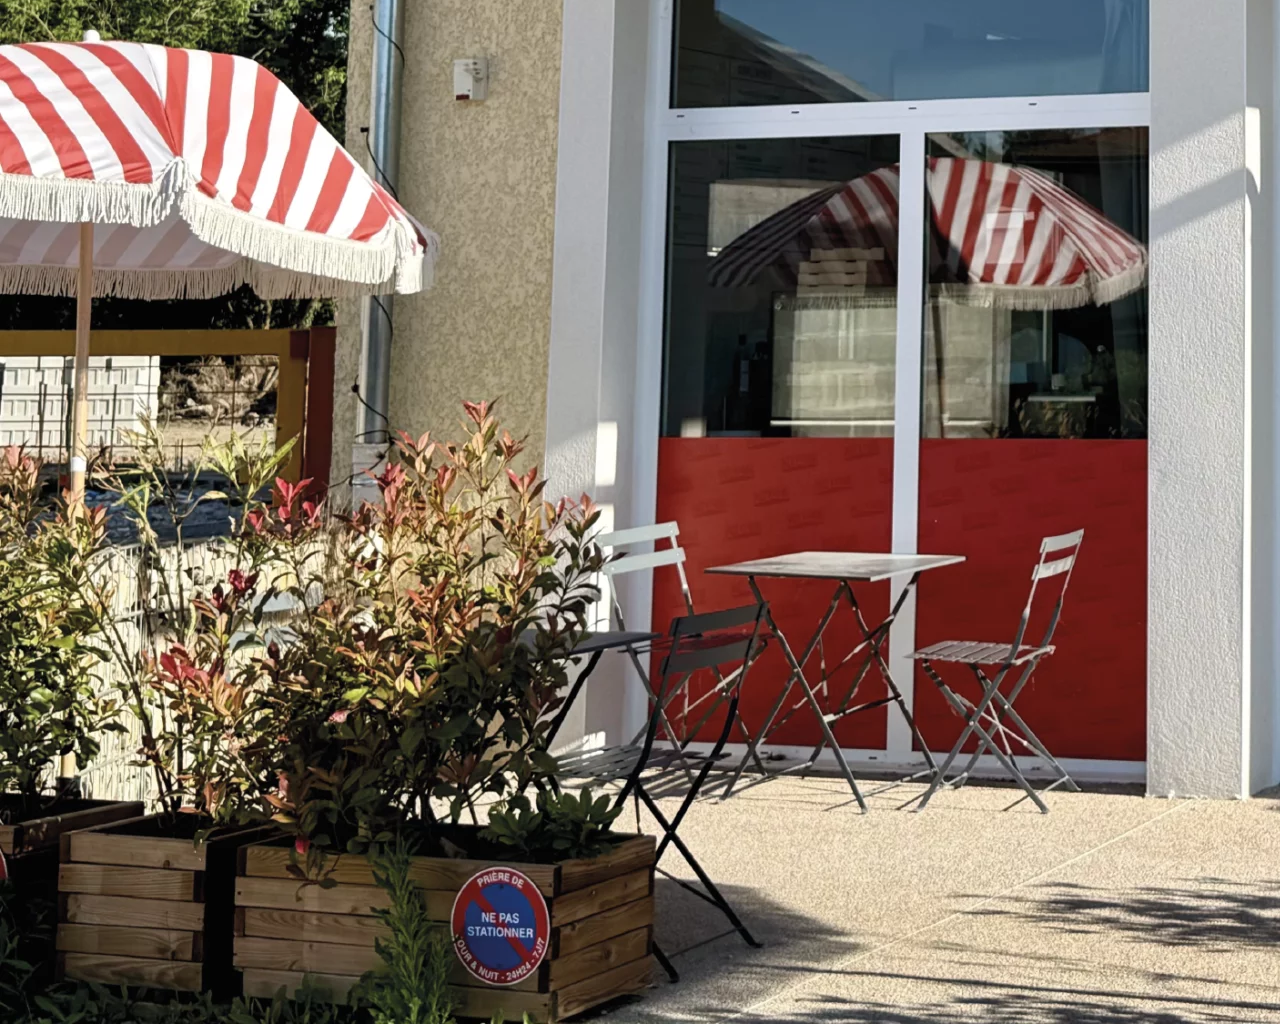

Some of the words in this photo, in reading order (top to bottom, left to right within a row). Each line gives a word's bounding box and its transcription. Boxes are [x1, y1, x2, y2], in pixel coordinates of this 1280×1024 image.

[476, 871, 510, 888] PRIÈRE
[511, 875, 525, 889] DE
[481, 912, 497, 924] NE
[499, 912, 520, 924] PAS
[467, 926, 534, 938] STATIONNER
[455, 934, 473, 962] OUR
[478, 966, 499, 981] NUIT
[506, 961, 532, 981] 24H24
